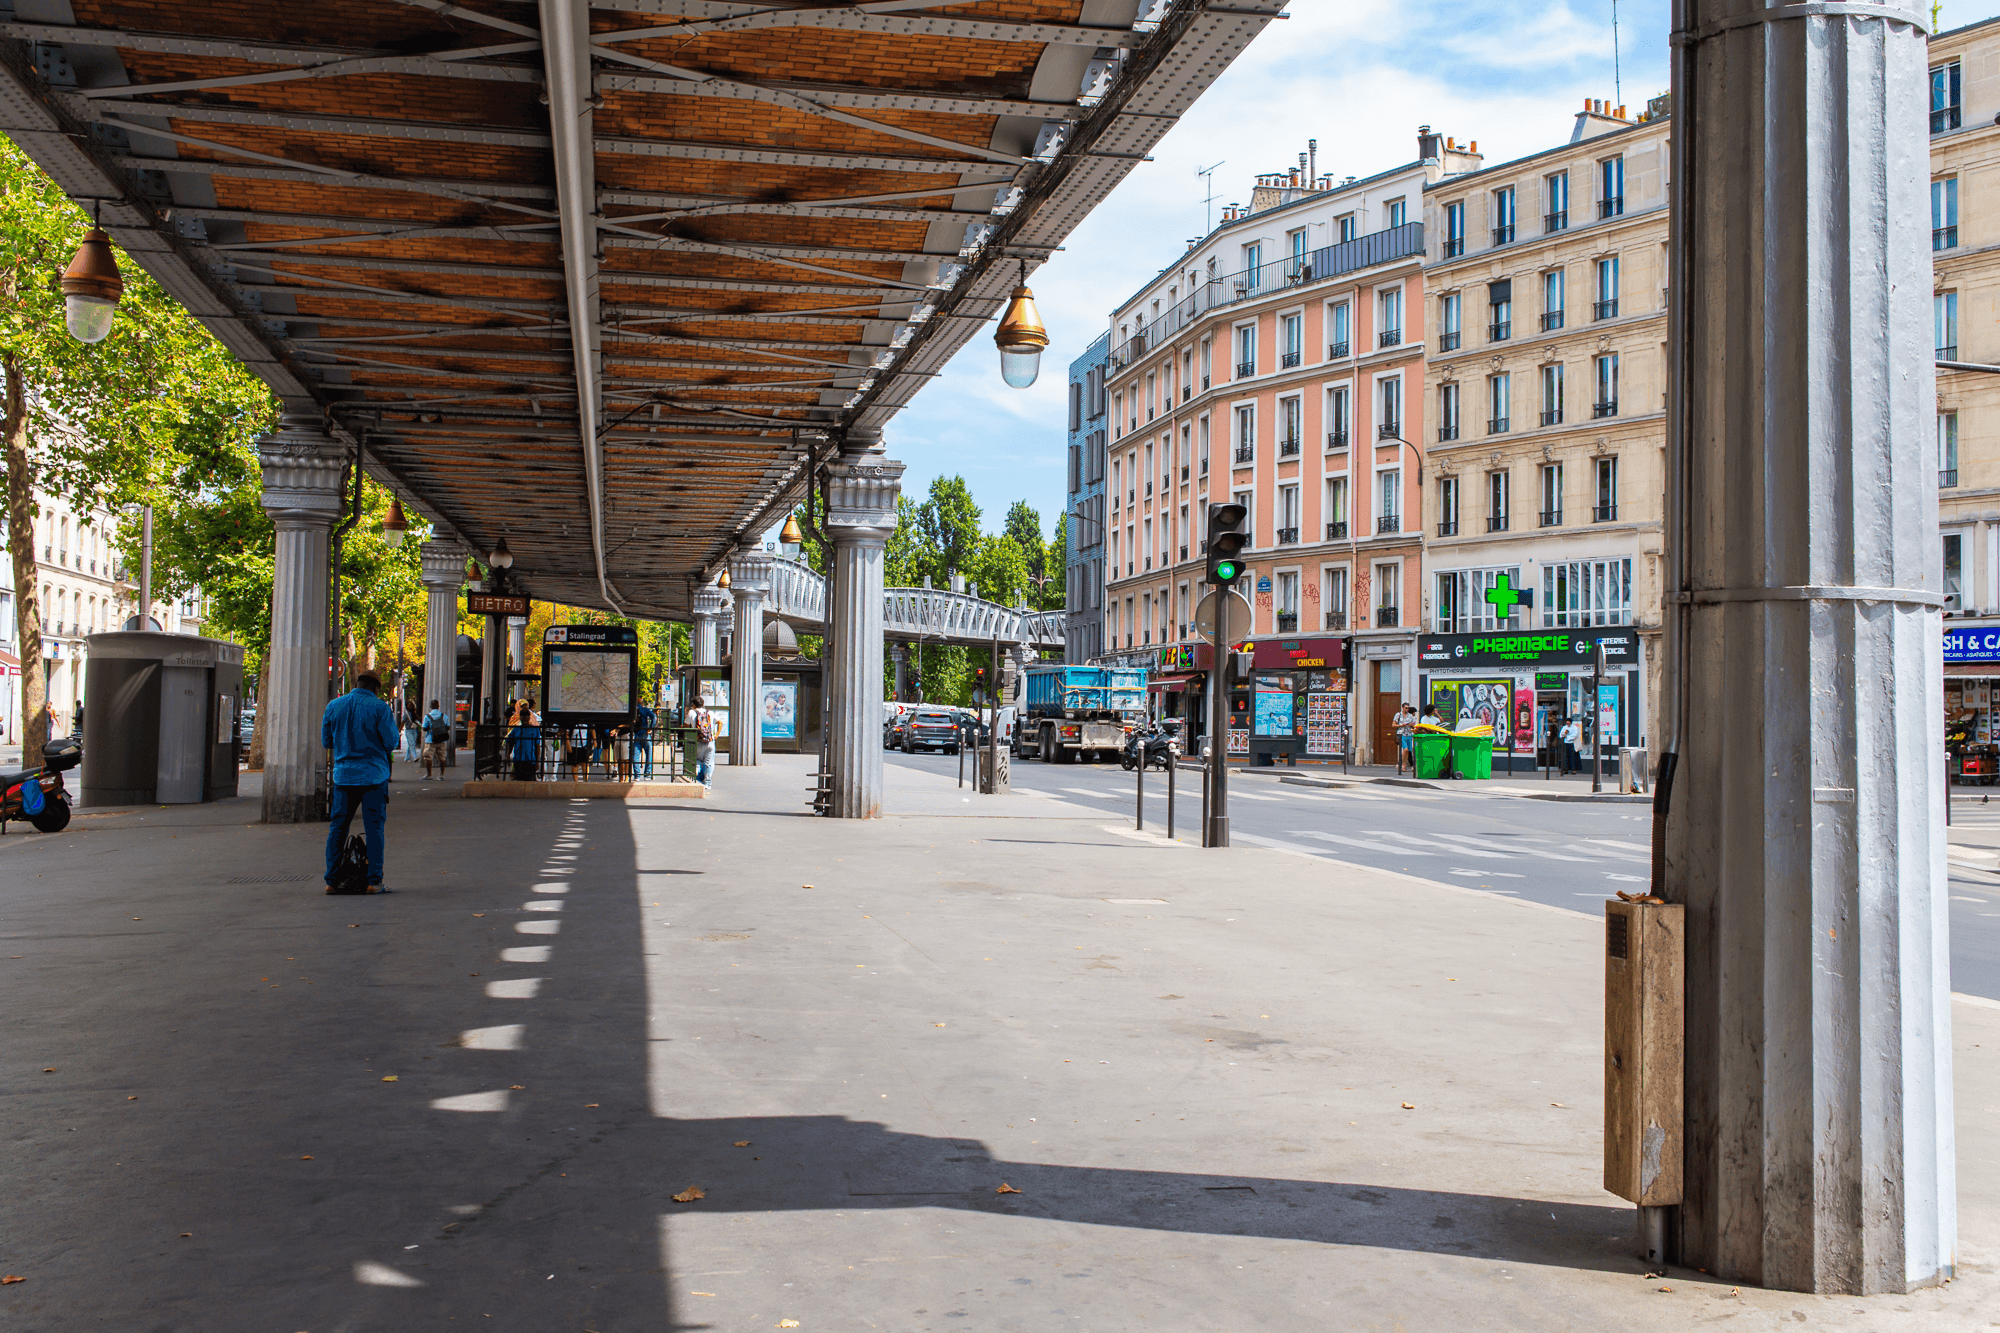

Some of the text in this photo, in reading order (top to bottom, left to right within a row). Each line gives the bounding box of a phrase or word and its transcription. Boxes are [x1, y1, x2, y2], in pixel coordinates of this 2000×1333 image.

[474, 597, 523, 611] METRO
[569, 632, 606, 641] Stalingrad
[1282, 641, 1300, 650] PARIS
[1473, 635, 1569, 653] PHARMACIE
[1603, 647, 1628, 655] EDICAL
[1161, 647, 1177, 665] PFC
[176, 657, 209, 666] Toilettes
[1296, 658, 1325, 667] CHICKEN
